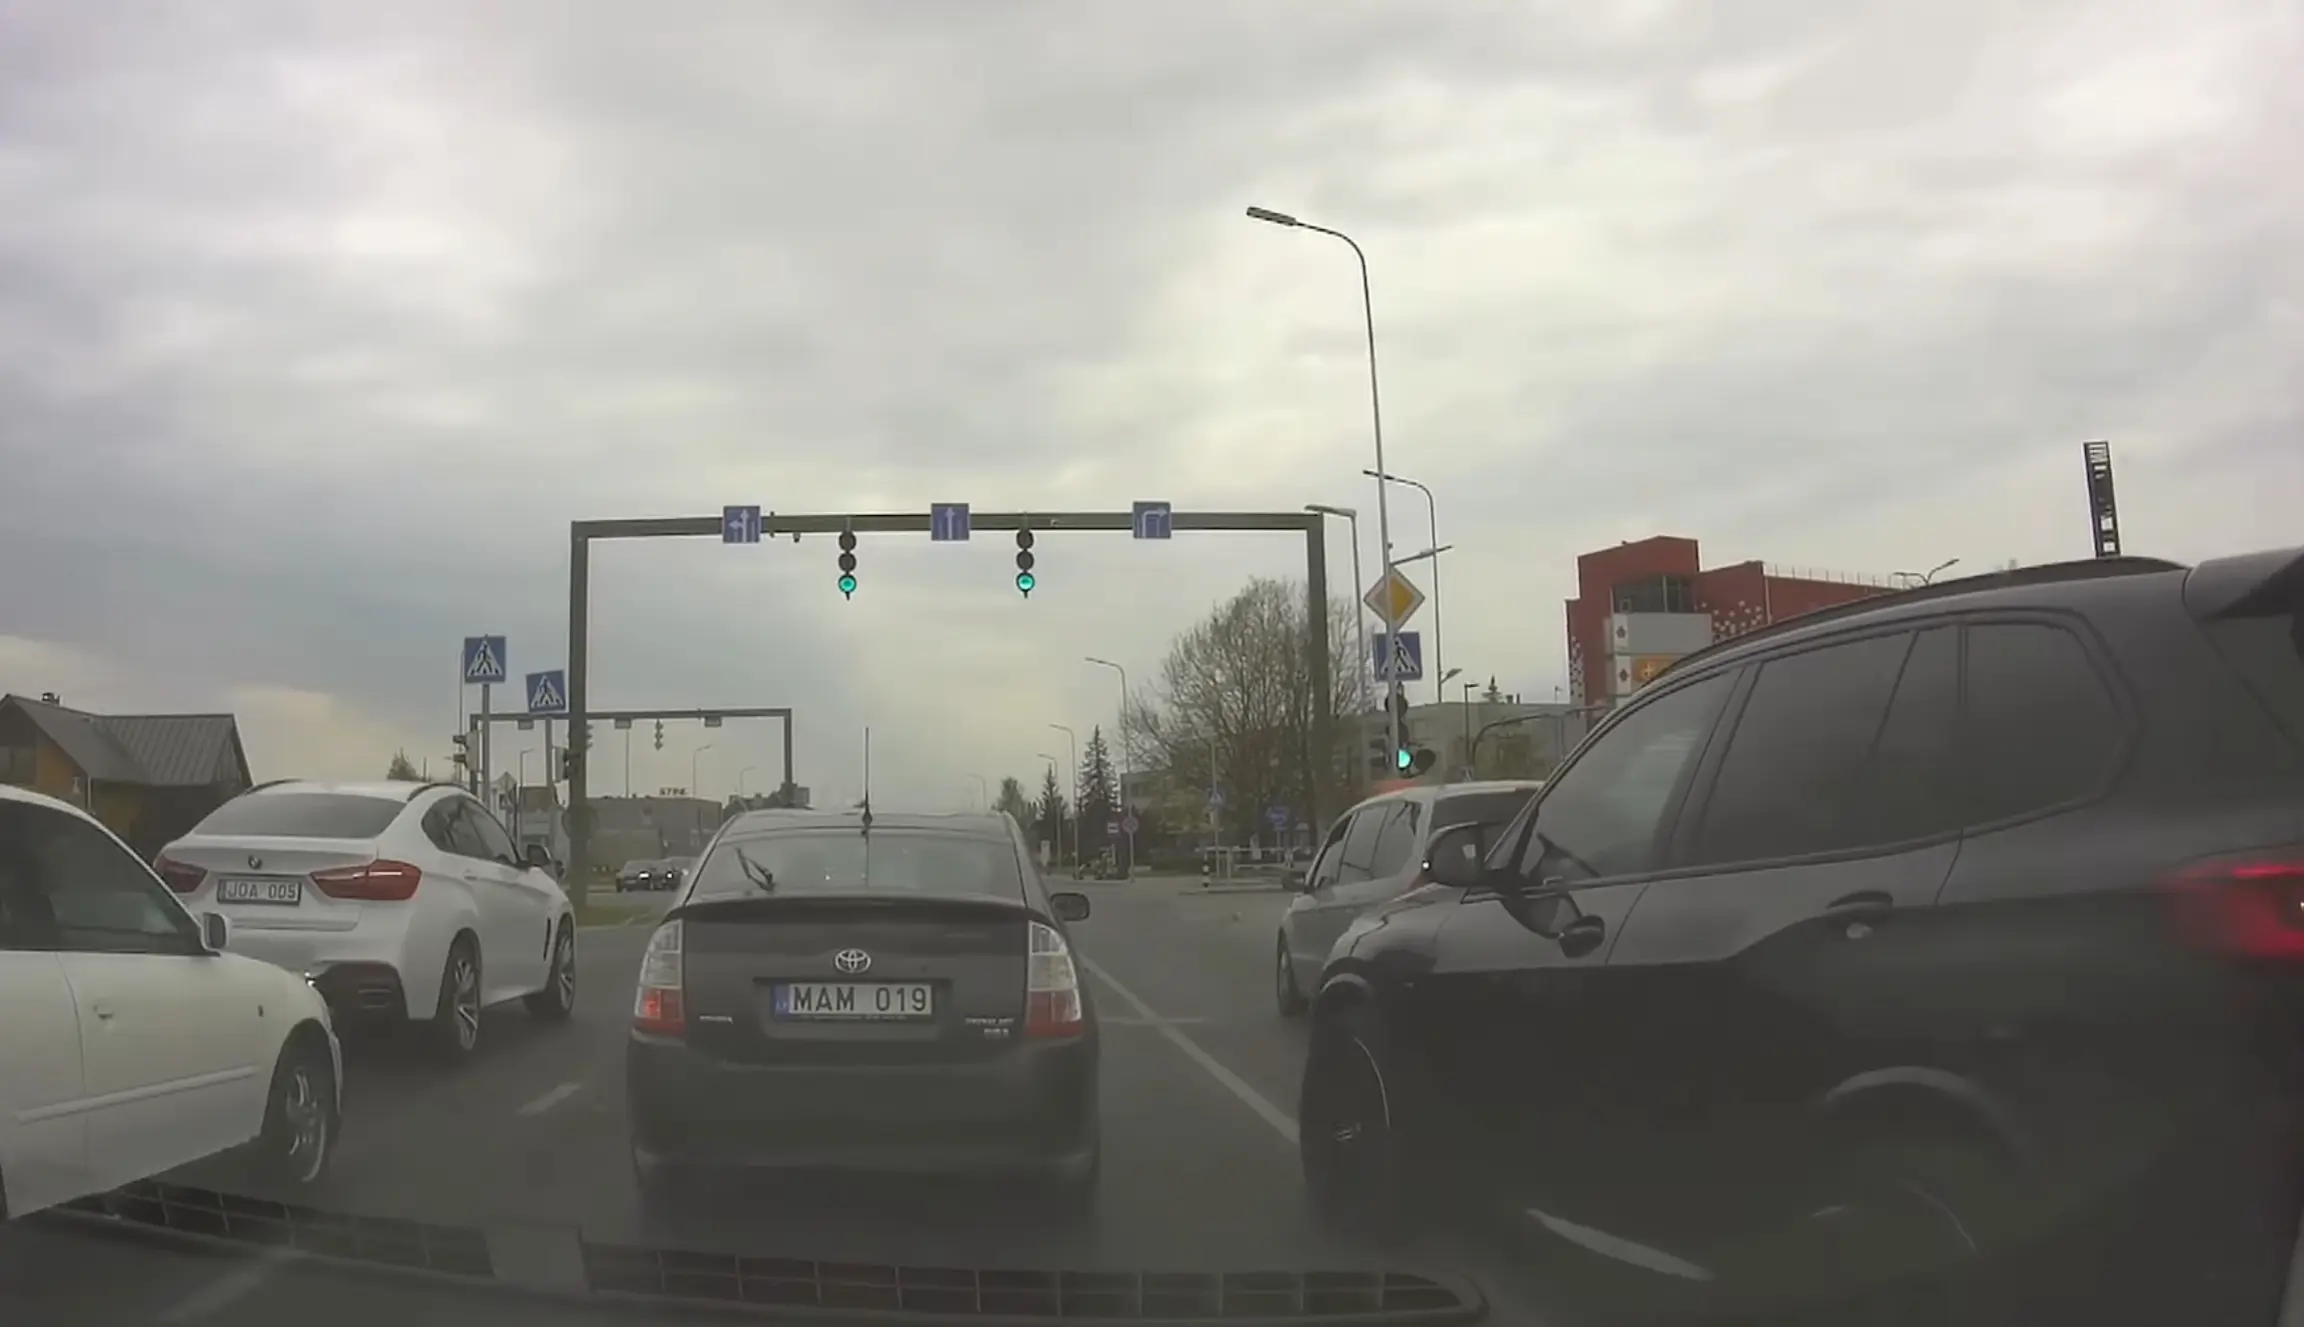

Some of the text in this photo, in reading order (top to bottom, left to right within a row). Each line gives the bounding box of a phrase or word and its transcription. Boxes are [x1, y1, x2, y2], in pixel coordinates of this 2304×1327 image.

[228, 881, 297, 900] JOA 005
[793, 986, 927, 1012] MAM 019
